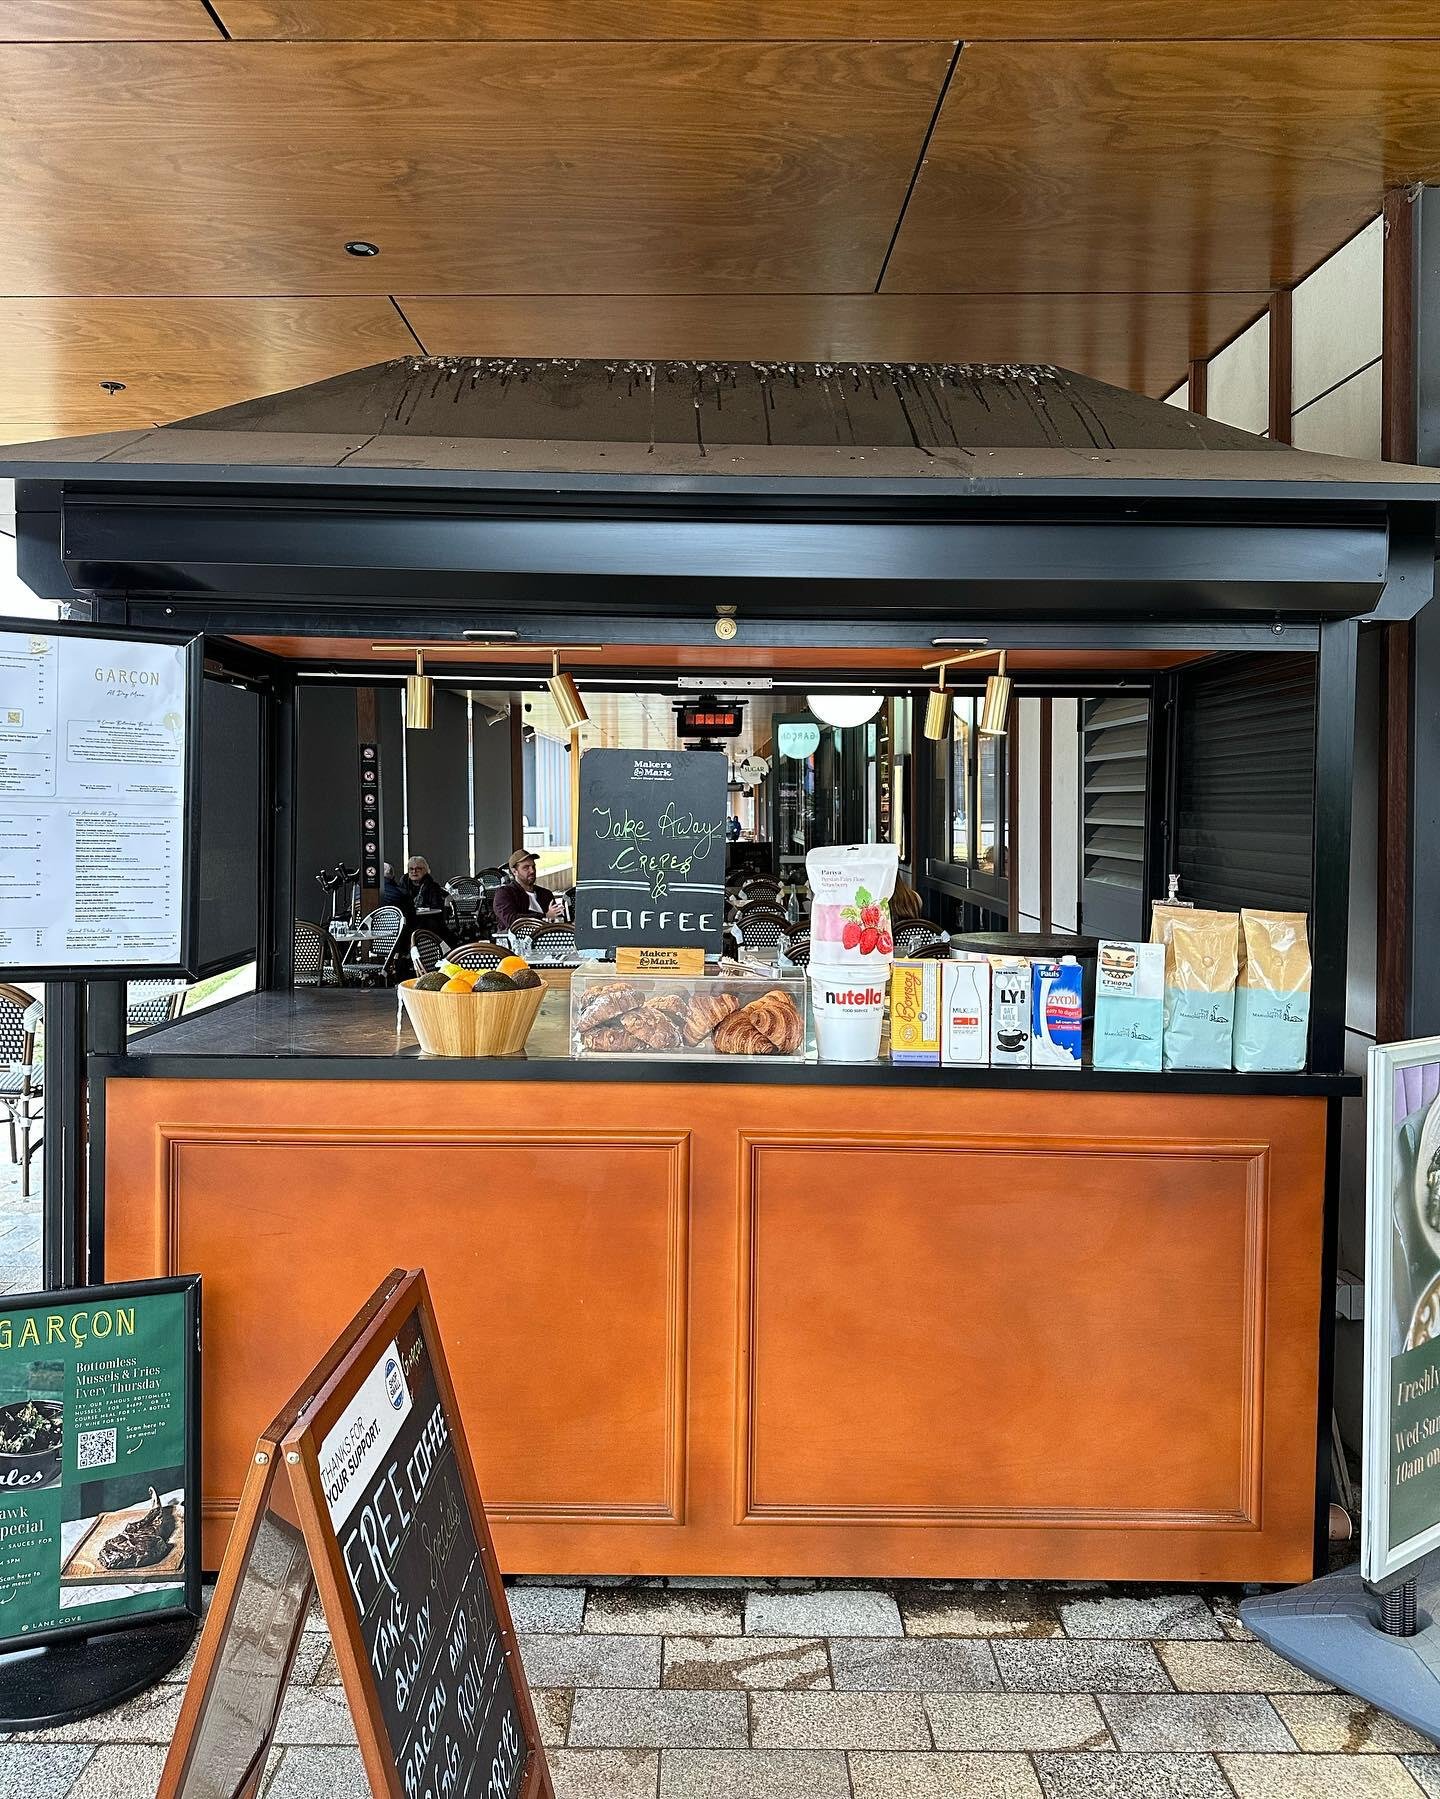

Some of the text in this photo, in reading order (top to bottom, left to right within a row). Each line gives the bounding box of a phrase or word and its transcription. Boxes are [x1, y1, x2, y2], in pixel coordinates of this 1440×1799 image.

[95, 668, 160, 687] GARÇON
[644, 769, 672, 777] Mark
[592, 802, 722, 859] Take Away
[651, 871, 668, 904] &
[592, 909, 717, 932] COFFEE
[650, 958, 679, 966] Mark
[826, 988, 882, 1005] nutella
[1001, 989, 1026, 1004] LY!
[0, 1307, 136, 1349] GARÇON
[76, 1357, 137, 1373] Bottomless
[76, 1366, 160, 1386] Mussels & Fries
[76, 1378, 162, 1399] Every Thursday
[106, 1397, 130, 1405] FAMOUS
[133, 1392, 171, 1401] BOTTOMLESS
[75, 1408, 102, 1416] MUSSELS
[75, 1414, 98, 1422] COURSE
[149, 1403, 171, 1411] BOTTLE
[320, 1416, 367, 1490] THANKS FOR
[326, 1418, 382, 1508] YOUR SUPPORT.
[1396, 1456, 1425, 1486] 10am
[343, 1403, 448, 1616] FREE COFFEE
[8, 1541, 35, 1550] SAUCES
[0, 1573, 15, 1582] Scan
[17, 1571, 31, 1579] here
[33, 1620, 55, 1629] LANE
[59, 1616, 82, 1624] COVE
[372, 1592, 410, 1681] TAKE
[395, 1596, 431, 1712] AWAY
[405, 1680, 447, 1799] BACON
[449, 1609, 468, 1676] AND
[425, 1655, 484, 1799] GG ROLL
